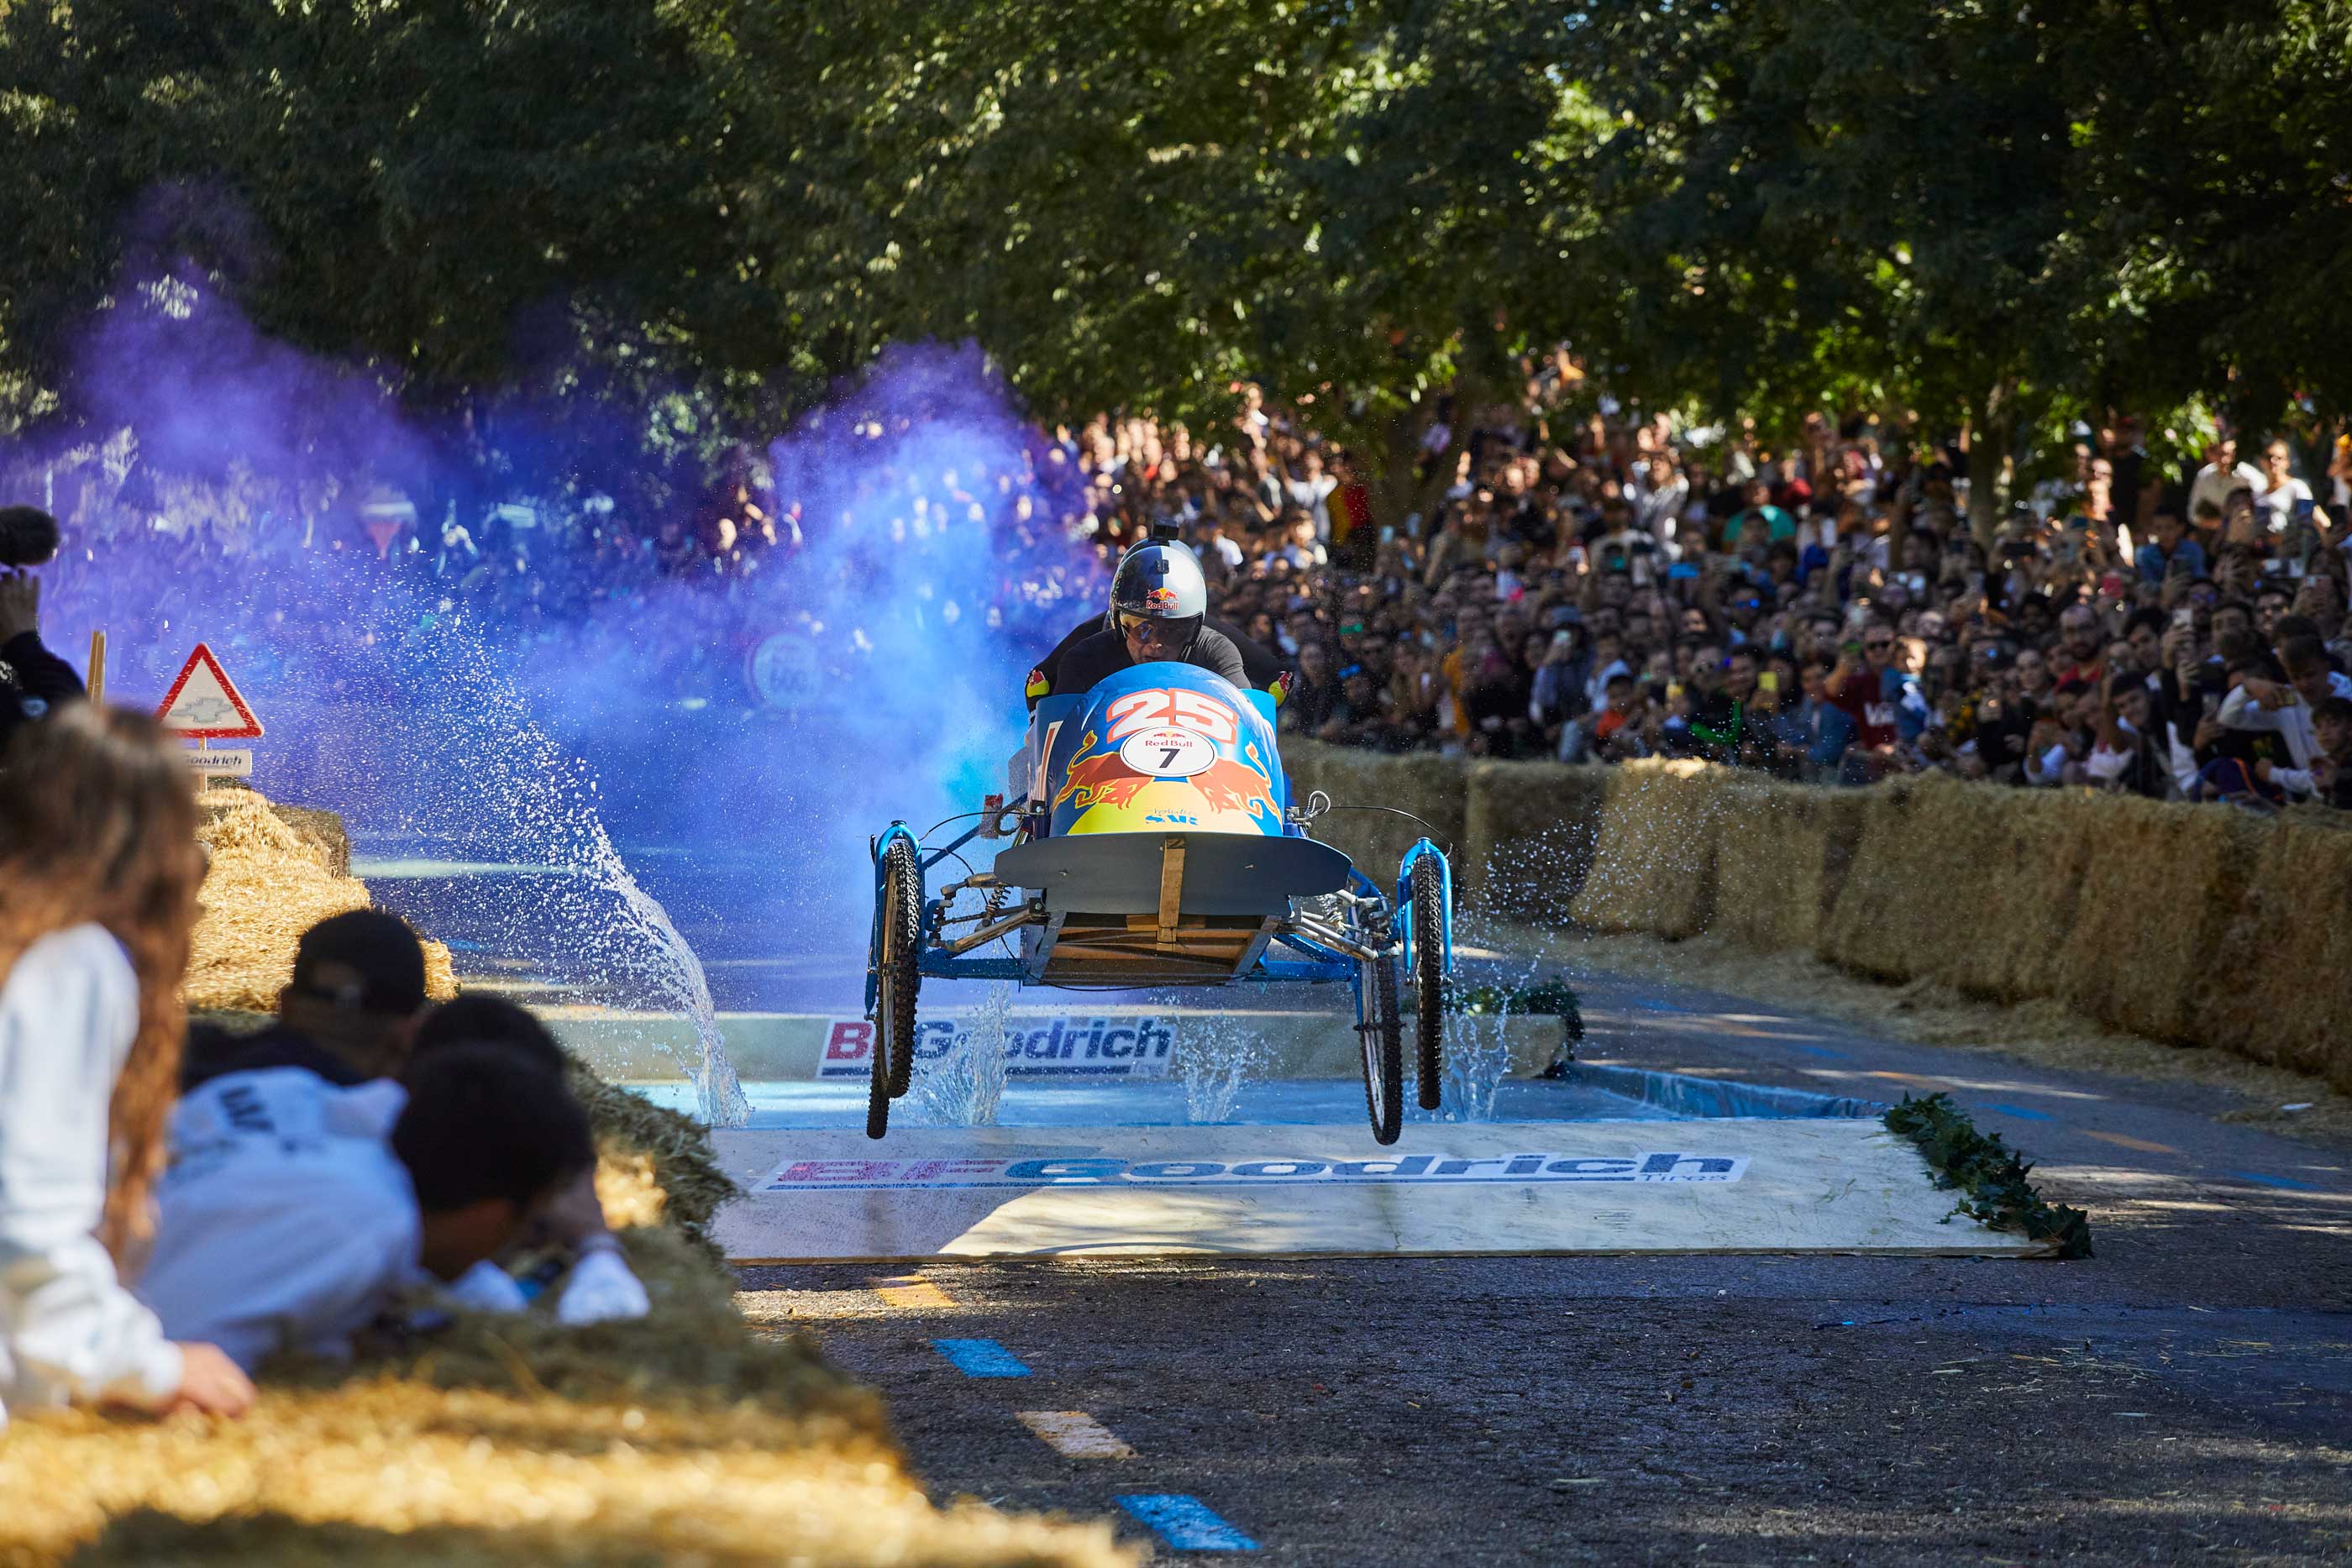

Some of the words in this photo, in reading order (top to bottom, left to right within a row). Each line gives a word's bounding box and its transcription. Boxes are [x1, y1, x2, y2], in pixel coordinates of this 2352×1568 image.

[1147, 600, 1163, 611] Red
[1163, 600, 1179, 611] Bull
[1106, 688, 1238, 745] 25
[1159, 747, 1180, 768] 7
[777, 1154, 1735, 1182] BFGoodrich
